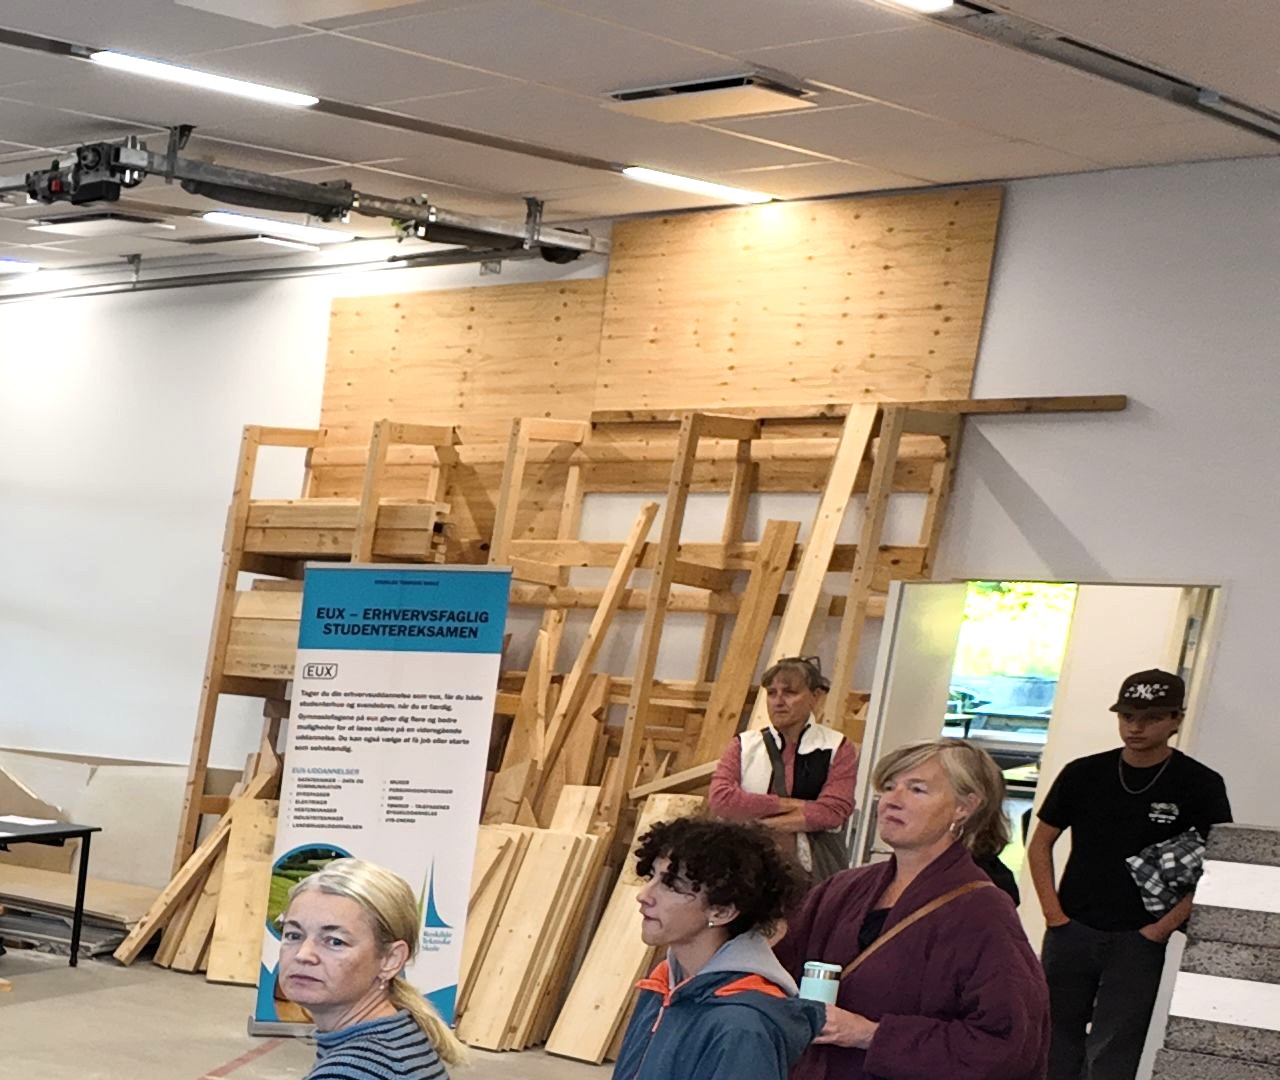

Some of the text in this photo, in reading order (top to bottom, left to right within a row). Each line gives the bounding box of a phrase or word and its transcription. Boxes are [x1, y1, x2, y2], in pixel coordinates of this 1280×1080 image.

[316, 607, 345, 619] EUX
[362, 608, 489, 623] ERHVERVSFAGLIG
[323, 623, 478, 638] STUDENTEREKSAMEN
[307, 665, 332, 677] EUX
